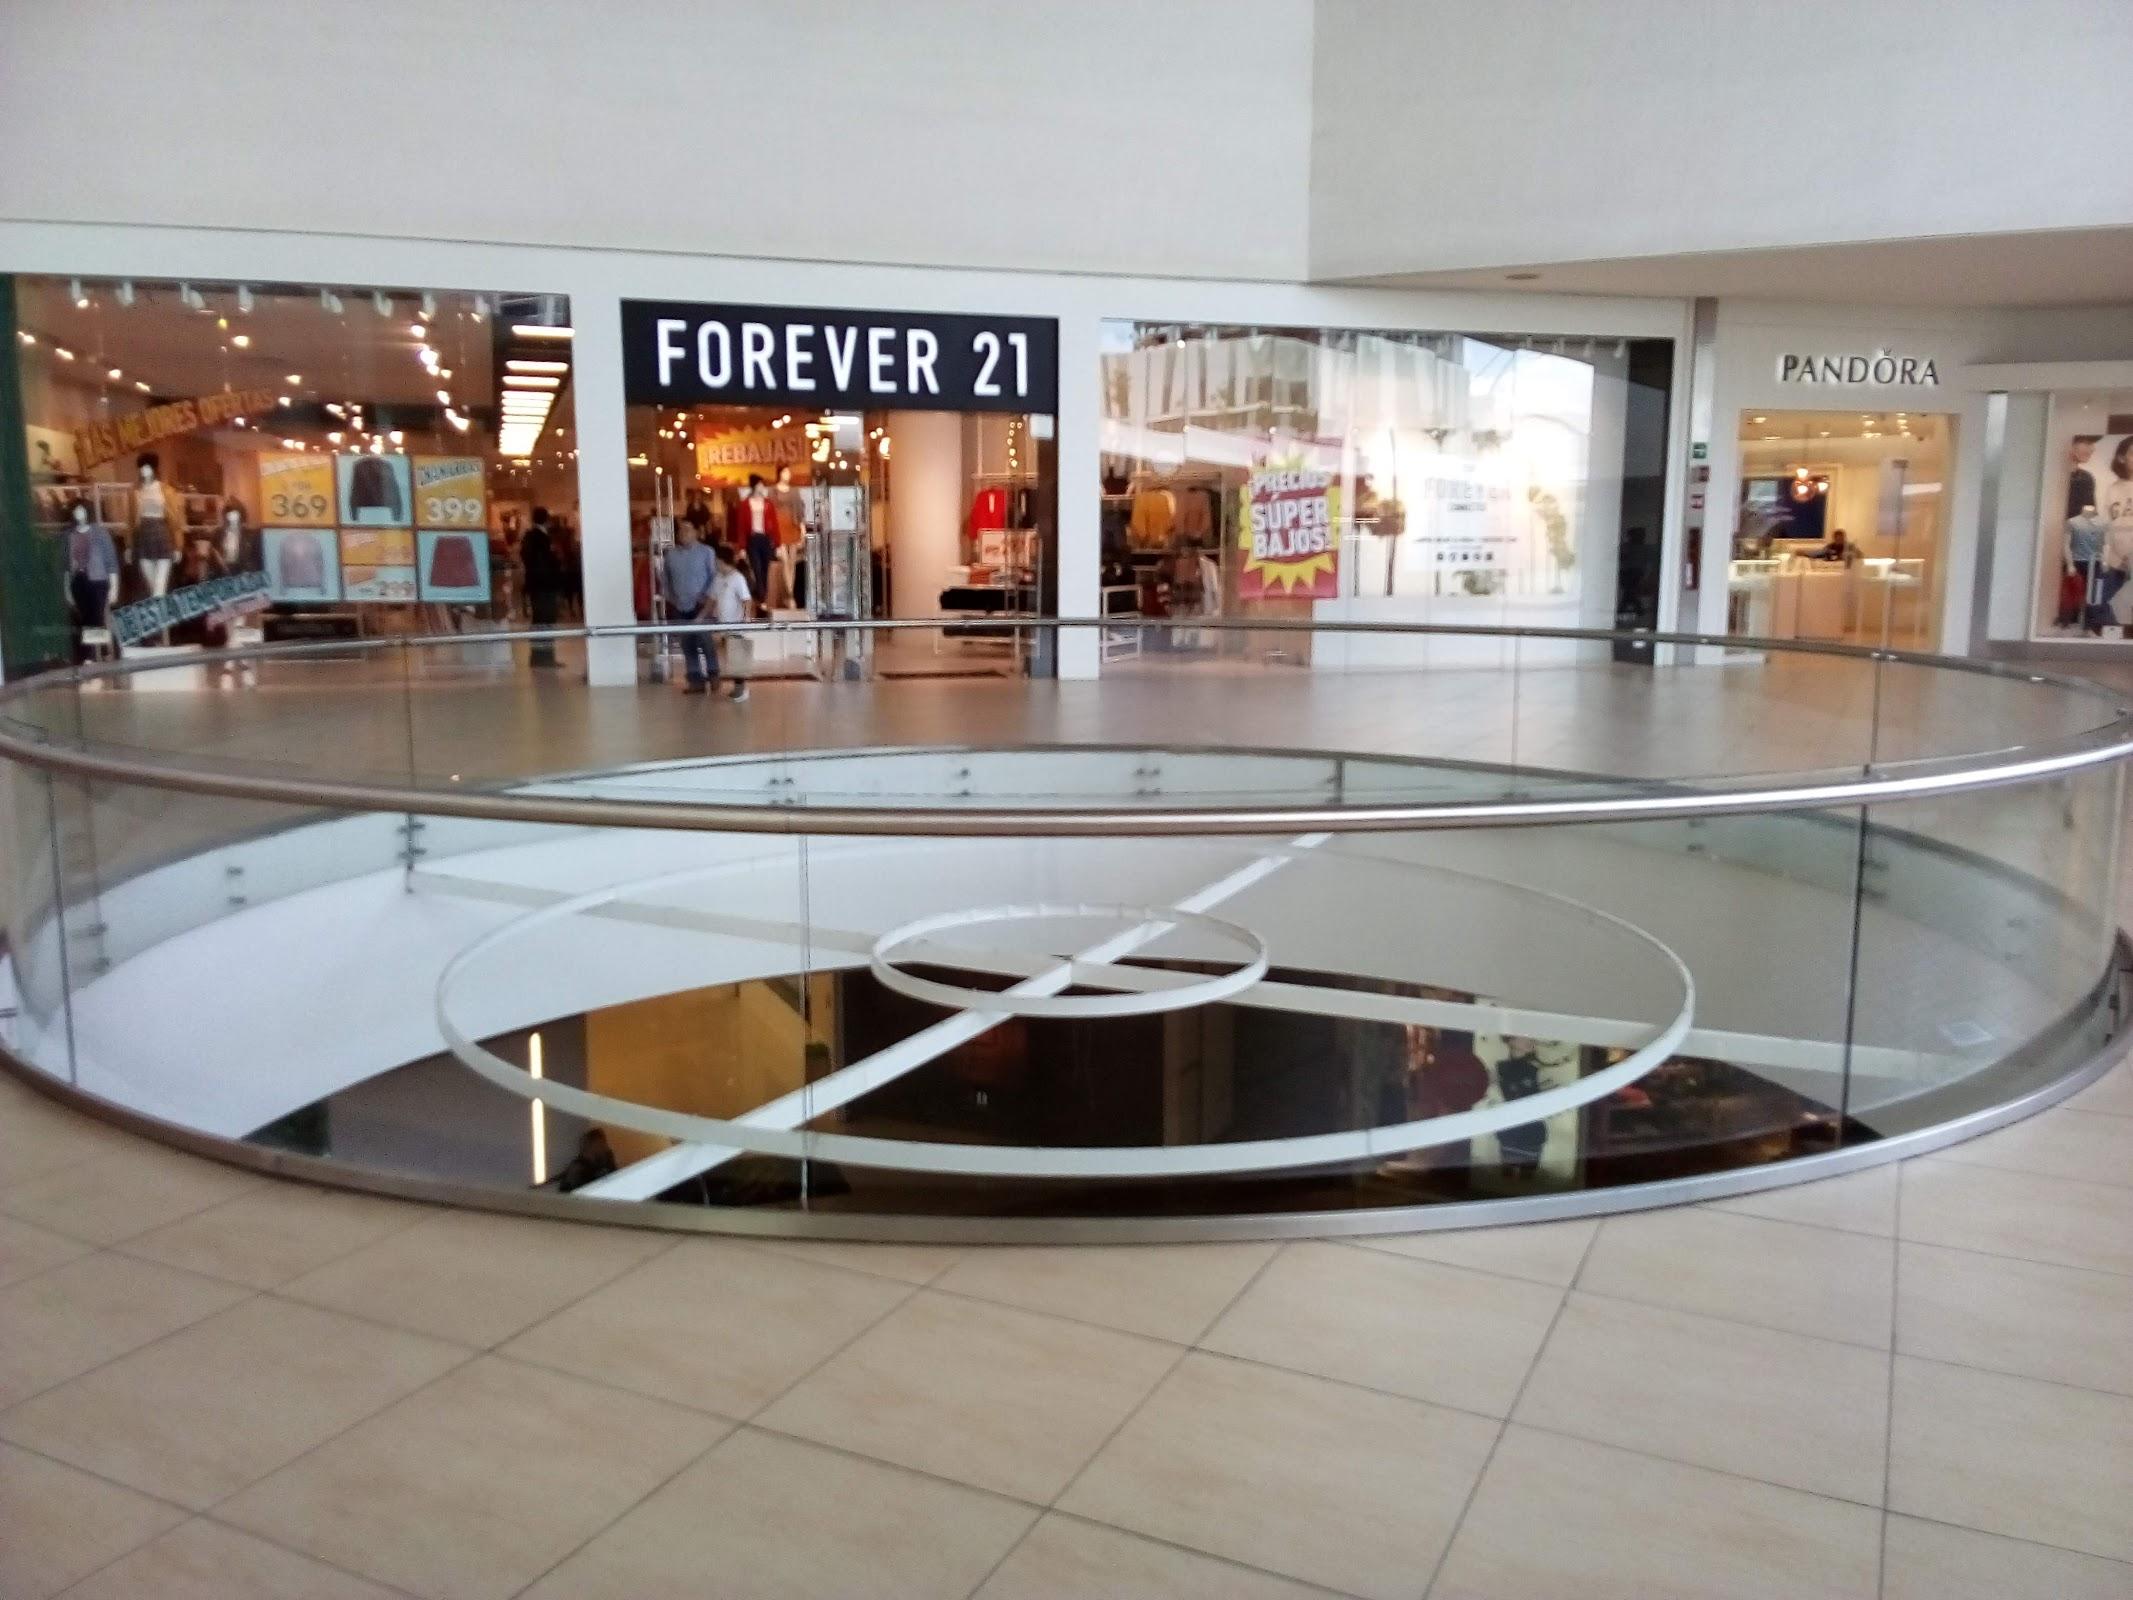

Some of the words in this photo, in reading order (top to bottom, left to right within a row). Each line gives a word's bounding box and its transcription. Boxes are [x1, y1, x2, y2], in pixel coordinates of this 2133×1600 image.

[656, 319, 939, 394] FOREVER
[972, 331, 1028, 397] 21
[1782, 350, 1939, 385] PANDORA
[271, 494, 326, 518] 369
[426, 498, 483, 522] 399
